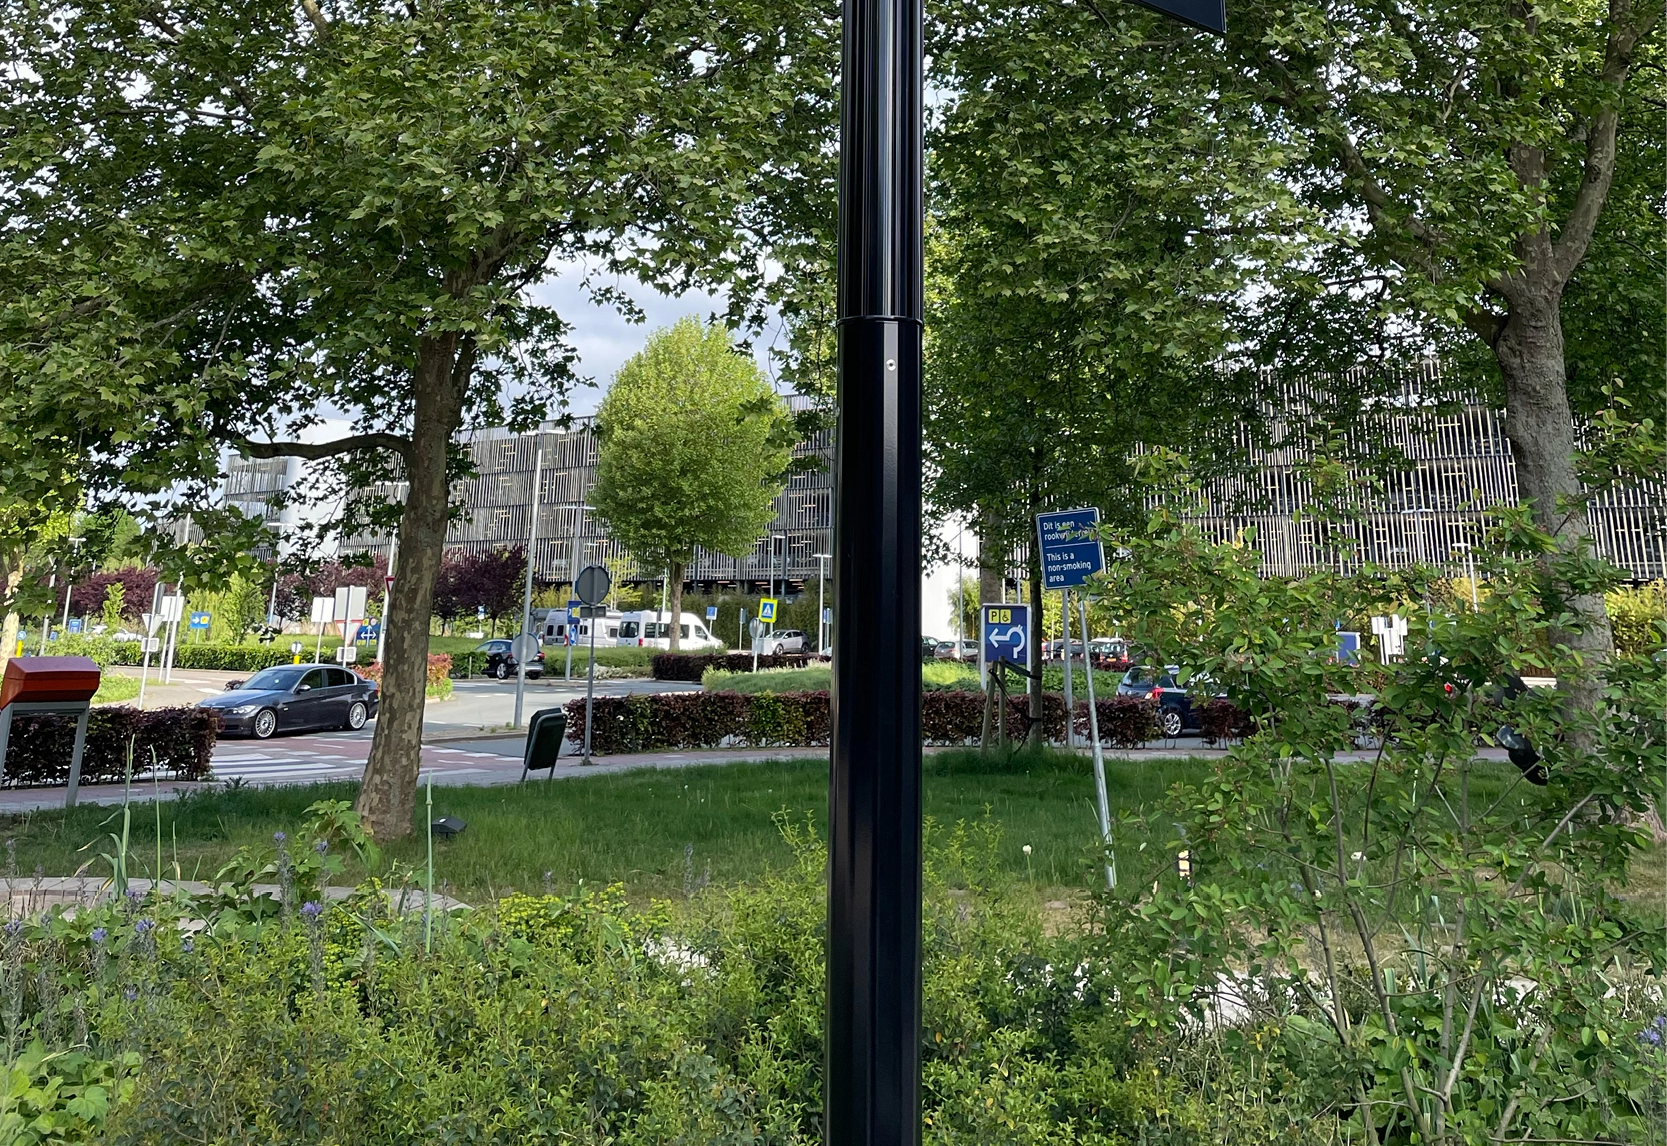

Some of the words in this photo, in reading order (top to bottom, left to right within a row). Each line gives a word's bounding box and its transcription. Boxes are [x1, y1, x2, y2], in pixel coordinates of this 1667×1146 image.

[1043, 521, 1053, 530] Dit
[1054, 521, 1061, 529] is
[1046, 552, 1061, 562] This
[1062, 552, 1069, 560] is
[1048, 561, 1091, 572] non-smoking
[1049, 574, 1064, 583] area
[991, 611, 997, 621] P
